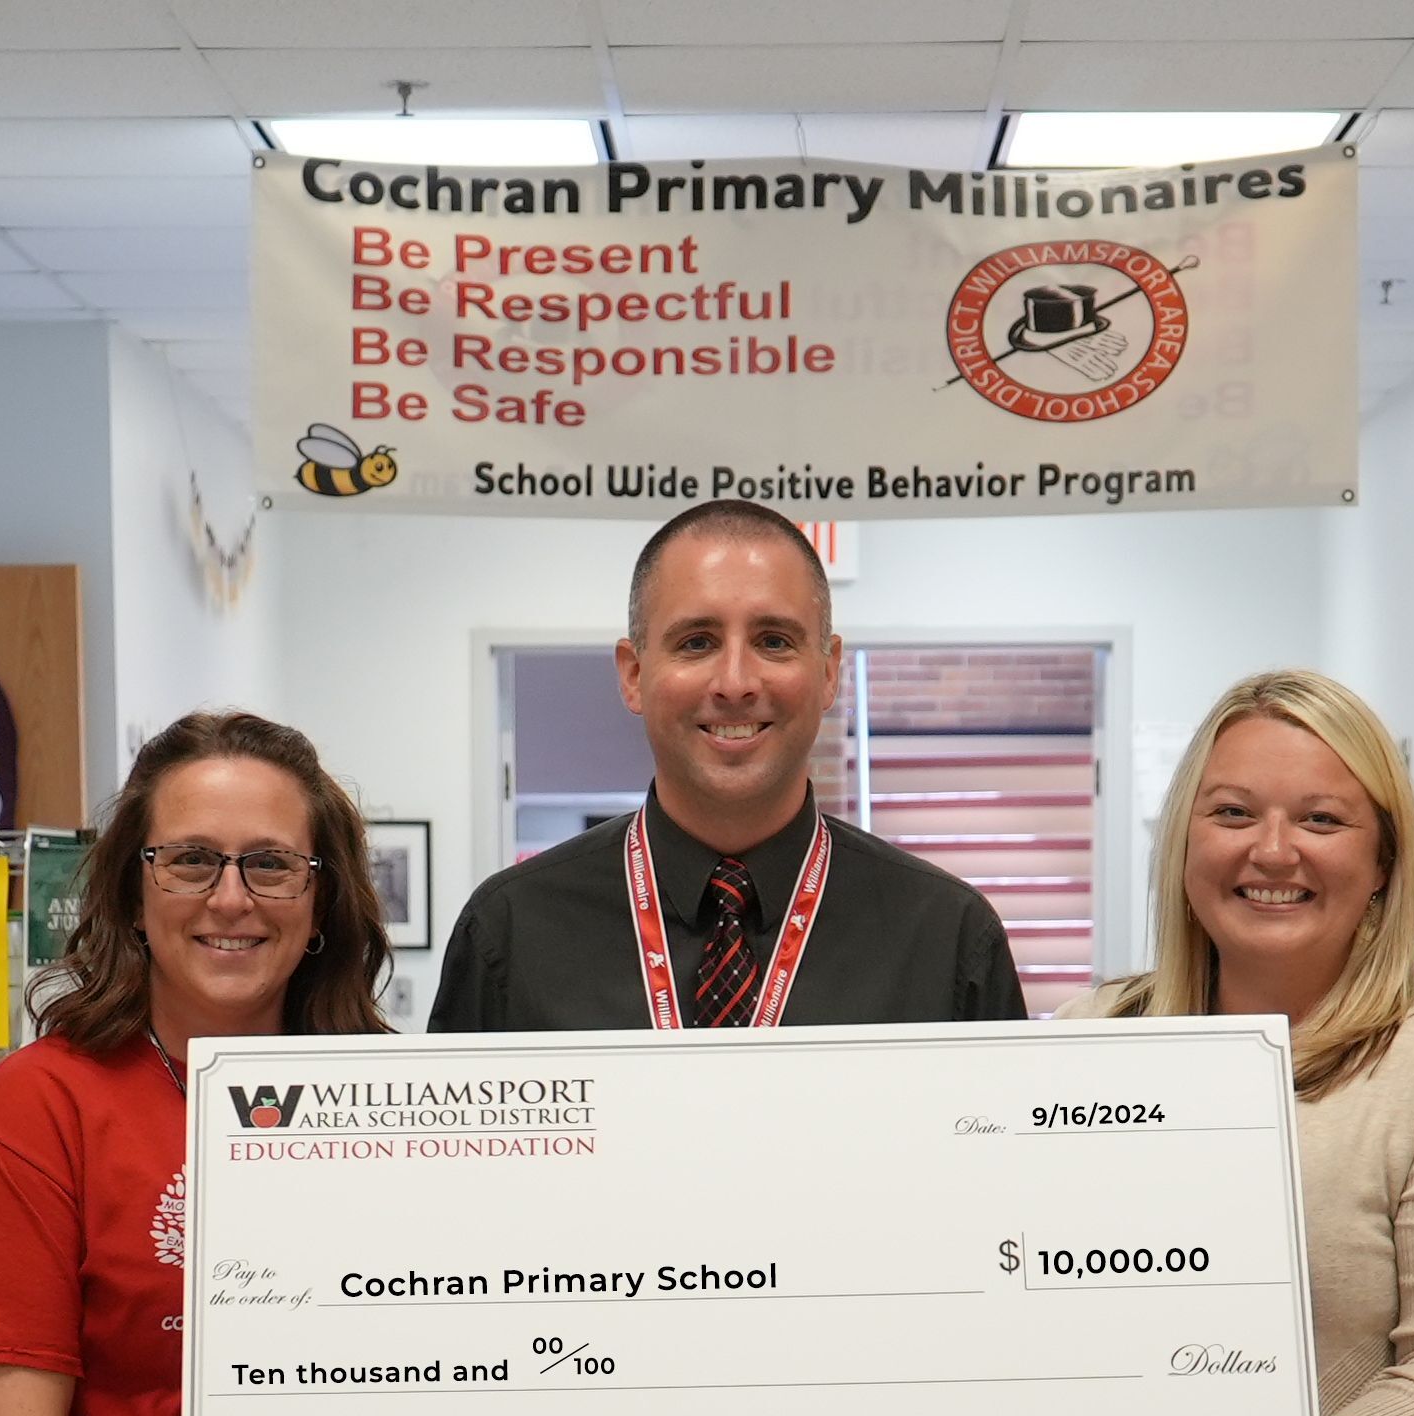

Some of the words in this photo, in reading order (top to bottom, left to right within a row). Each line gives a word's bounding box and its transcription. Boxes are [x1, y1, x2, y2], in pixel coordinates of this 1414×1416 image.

[302, 158, 580, 213] Cochran
[608, 160, 884, 224] Primary
[909, 163, 1306, 219] Millionaires
[352, 226, 430, 269] Be
[455, 234, 698, 275] Present
[352, 274, 430, 316] Be
[456, 280, 791, 331] Respectful
[352, 327, 428, 366] Be
[453, 333, 835, 384] Responsible
[351, 381, 428, 421] Be
[452, 384, 585, 427] Safe
[475, 461, 593, 498] School
[607, 465, 699, 499] Wide
[712, 464, 854, 500] Positive
[867, 462, 1025, 499] Behavior
[1038, 463, 1196, 504] Program
[311, 1078, 595, 1108] WILLIAMSPORT
[299, 1110, 362, 1129] AREA
[367, 1108, 472, 1128] SCHOOL
[479, 1106, 595, 1126] DISTRICT
[953, 1115, 1007, 1136] Date:
[1031, 1103, 1166, 1127] 9/16/2024
[229, 1138, 395, 1162] EDUCATION
[405, 1136, 596, 1160] FOUNDATION
[212, 1258, 258, 1286] Pay
[259, 1266, 277, 1281] to
[998, 1238, 1021, 1276] $
[1037, 1247, 1210, 1280] 10,000.00
[340, 1270, 489, 1299] Cochran
[502, 1266, 645, 1299] Primary
[657, 1264, 778, 1291] School
[209, 1290, 235, 1307] the
[238, 1290, 287, 1307] order
[290, 1290, 313, 1312] of:
[232, 1363, 286, 1385] Ten
[297, 1360, 441, 1384] thousand
[452, 1358, 509, 1382] and
[1168, 1343, 1277, 1378] Dollars
